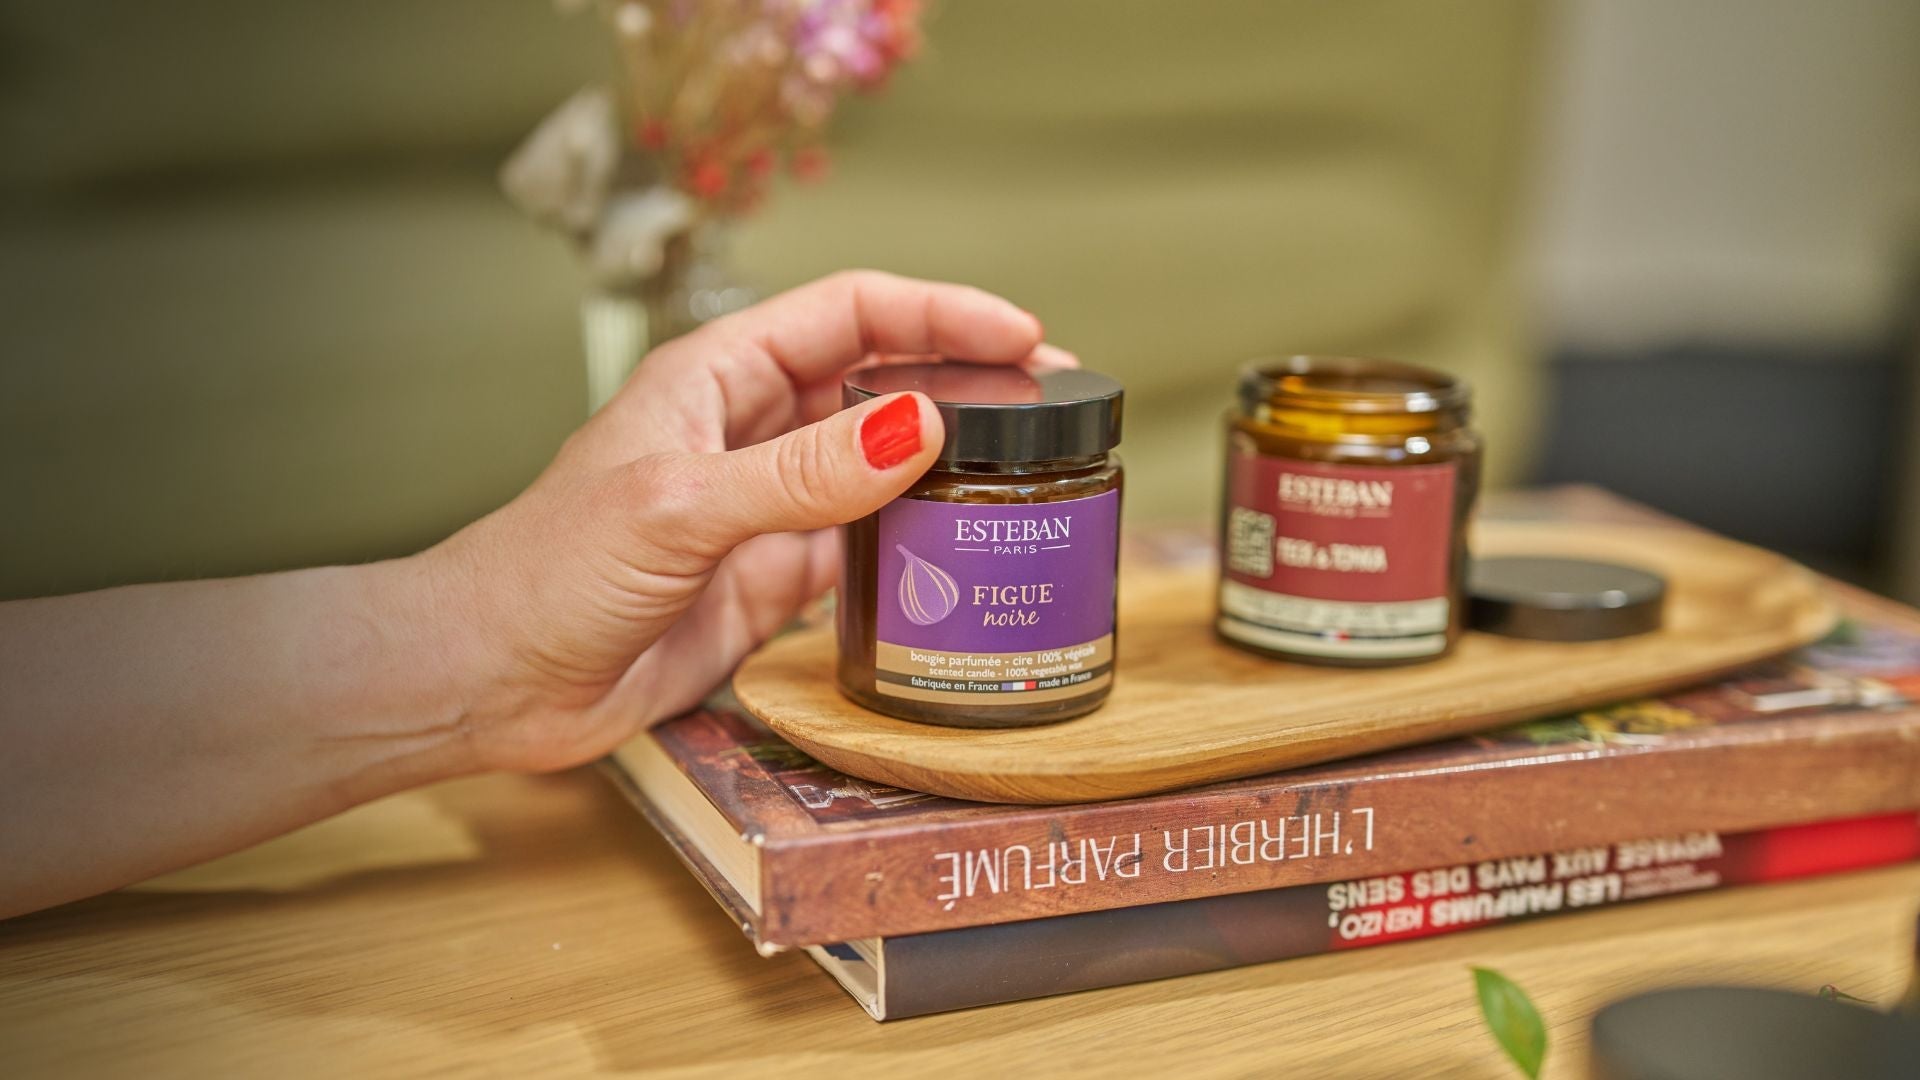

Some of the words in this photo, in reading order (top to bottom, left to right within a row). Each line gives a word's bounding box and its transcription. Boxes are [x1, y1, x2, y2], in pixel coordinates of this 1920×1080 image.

[955, 516, 1072, 542] ESTEBAN
[993, 544, 1038, 555] PARIS
[972, 584, 1054, 606] FIGUE
[983, 609, 1041, 627] noire
[910, 650, 946, 667] bougie
[949, 655, 1002, 668] parfumée
[1012, 655, 1033, 666] cire
[1037, 651, 1063, 665] 100%
[928, 667, 964, 677] scented
[966, 668, 996, 678] candle
[1005, 667, 1029, 677] 100%
[911, 676, 952, 691] fabriquée
[953, 682, 966, 691] en
[968, 681, 999, 691] France
[1038, 676, 1060, 689] made
[1061, 675, 1070, 685] in
[1070, 671, 1093, 684] France
[934, 833, 1140, 911] PARFUMÉ
[1476, 857, 1546, 890] PAYS
[1552, 847, 1609, 880] AUX
[1327, 876, 1405, 911] SENS
[1411, 866, 1470, 899] DES
[1567, 873, 1622, 907] LES
[1430, 882, 1563, 928] PARFUMS
